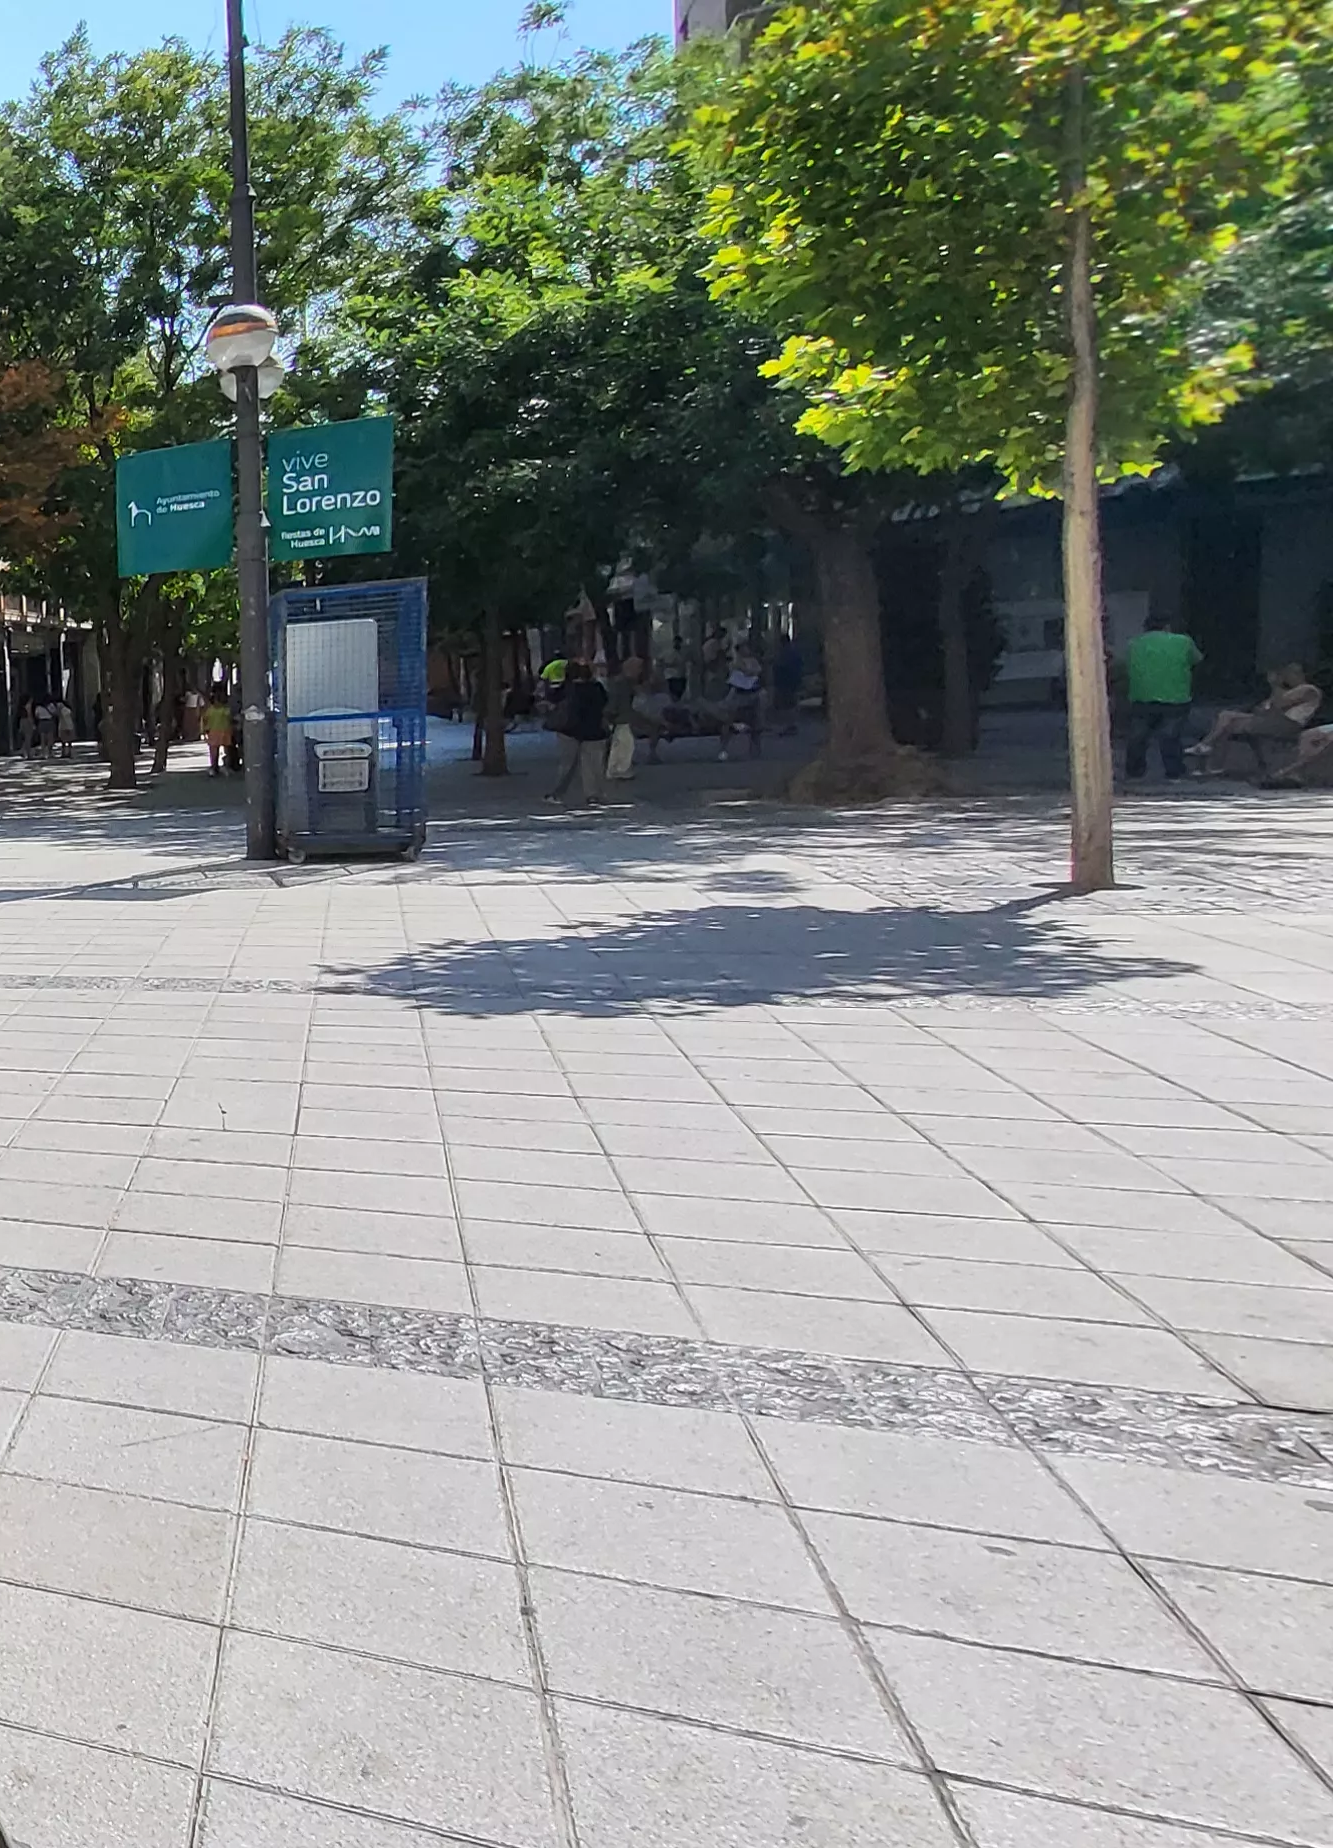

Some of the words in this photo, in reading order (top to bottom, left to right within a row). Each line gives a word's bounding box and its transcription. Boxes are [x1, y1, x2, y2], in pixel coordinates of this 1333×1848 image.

[282, 450, 328, 473] vive
[283, 471, 328, 493] San
[156, 490, 221, 506] Ayuntamiento
[283, 489, 381, 516] Lorenzo
[156, 505, 168, 514] de
[170, 501, 205, 512] Huesca
[313, 527, 325, 536] de
[290, 538, 325, 549] Huesca
